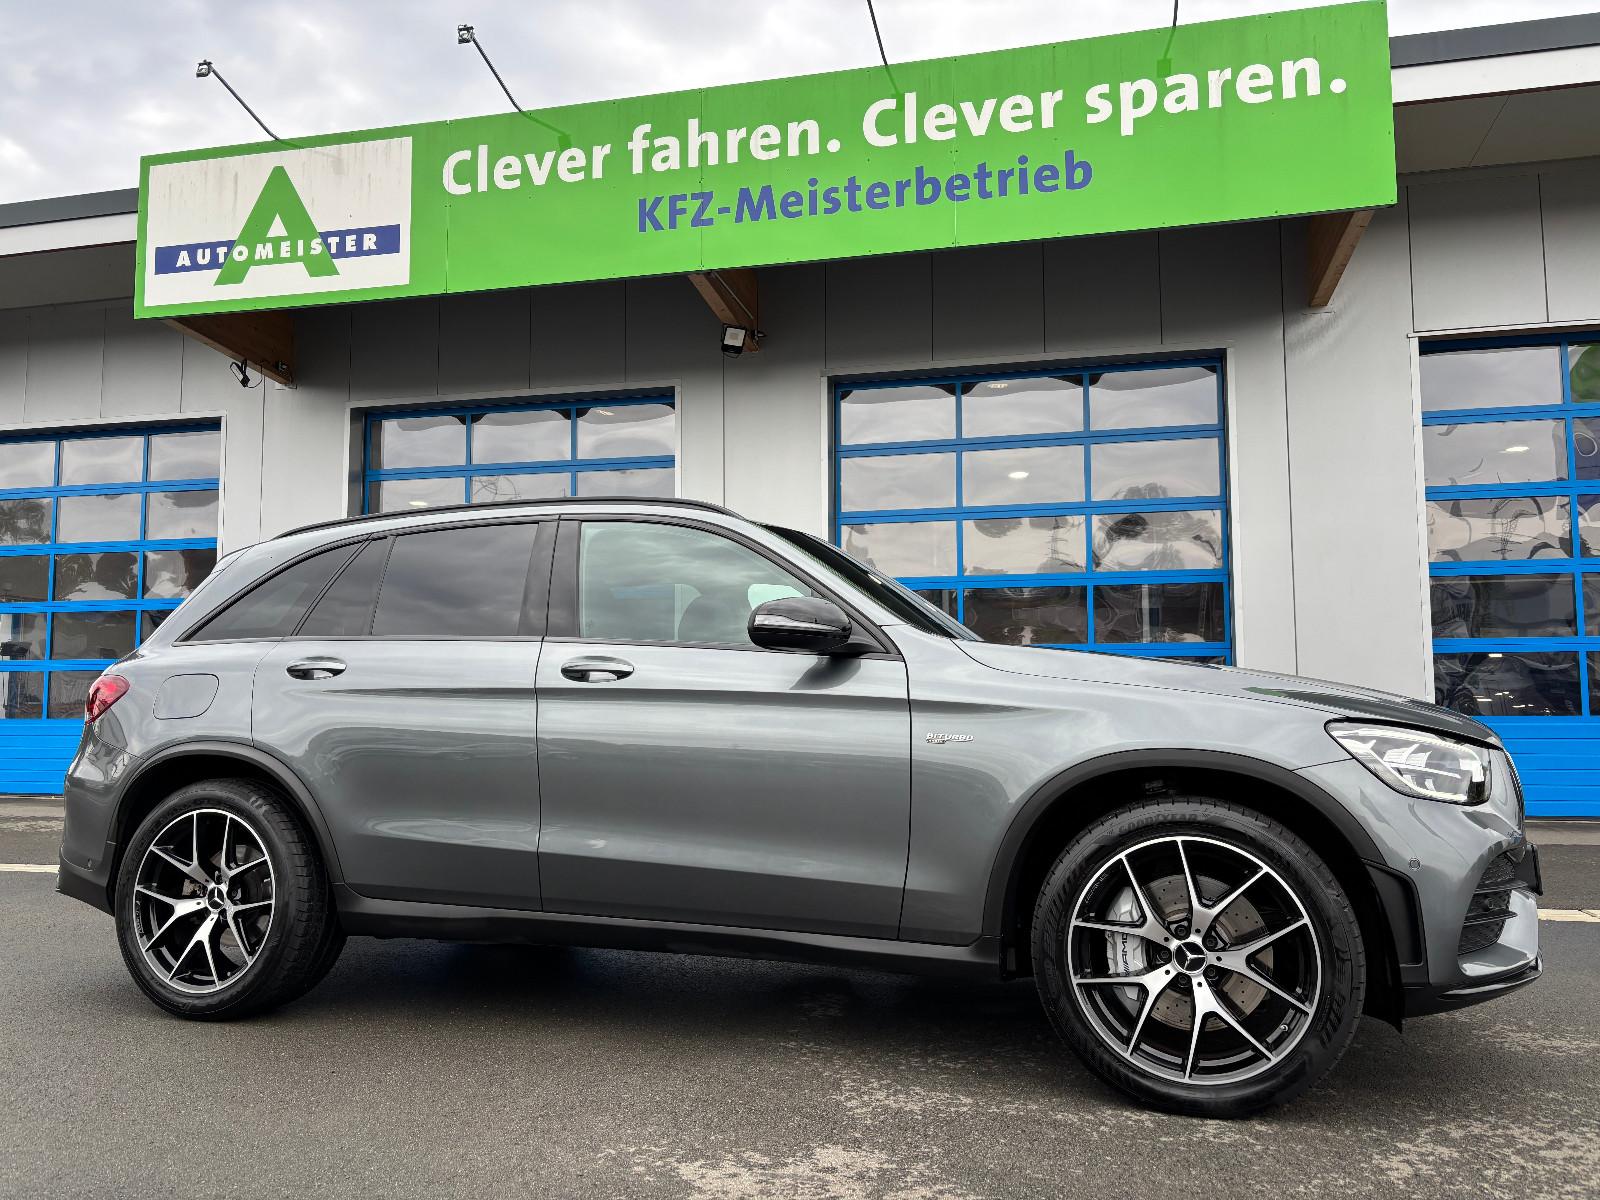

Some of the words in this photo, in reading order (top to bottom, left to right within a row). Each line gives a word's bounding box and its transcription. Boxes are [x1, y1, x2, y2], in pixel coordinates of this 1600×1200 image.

[442, 144, 612, 195] Clever
[627, 118, 841, 175] fahren.
[862, 90, 1064, 147] Clever
[1085, 57, 1347, 137] sparen.
[213, 165, 340, 286] A
[637, 151, 1093, 232] KFZ-Meisterbetrieb
[175, 233, 378, 268] AUTOMEISTER
[926, 732, 974, 743] BITURBO
